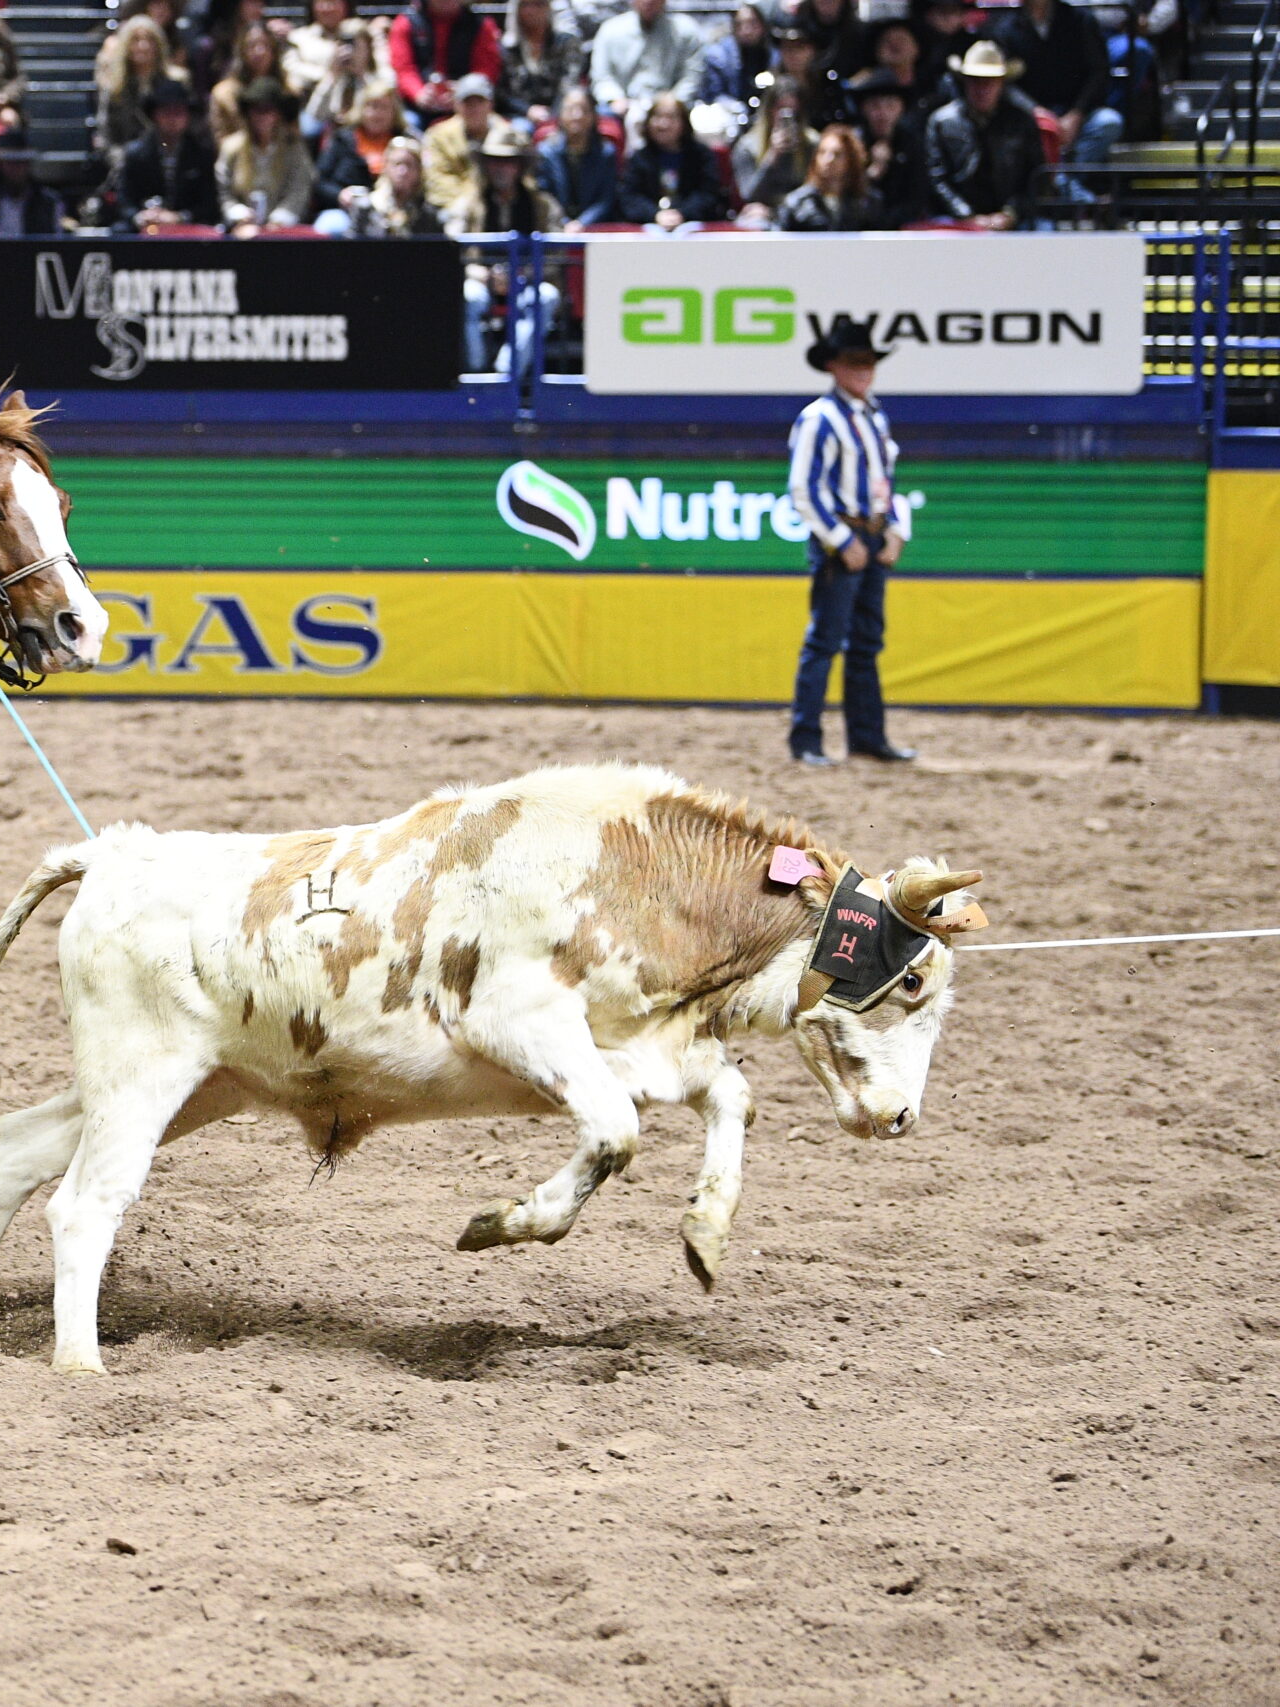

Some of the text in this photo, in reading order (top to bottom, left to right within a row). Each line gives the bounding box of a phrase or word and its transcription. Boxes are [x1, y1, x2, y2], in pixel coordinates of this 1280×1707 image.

[36, 252, 239, 318] MONTANA
[89, 312, 349, 381] SILVERSMITHS
[836, 908, 877, 931] WNFR
